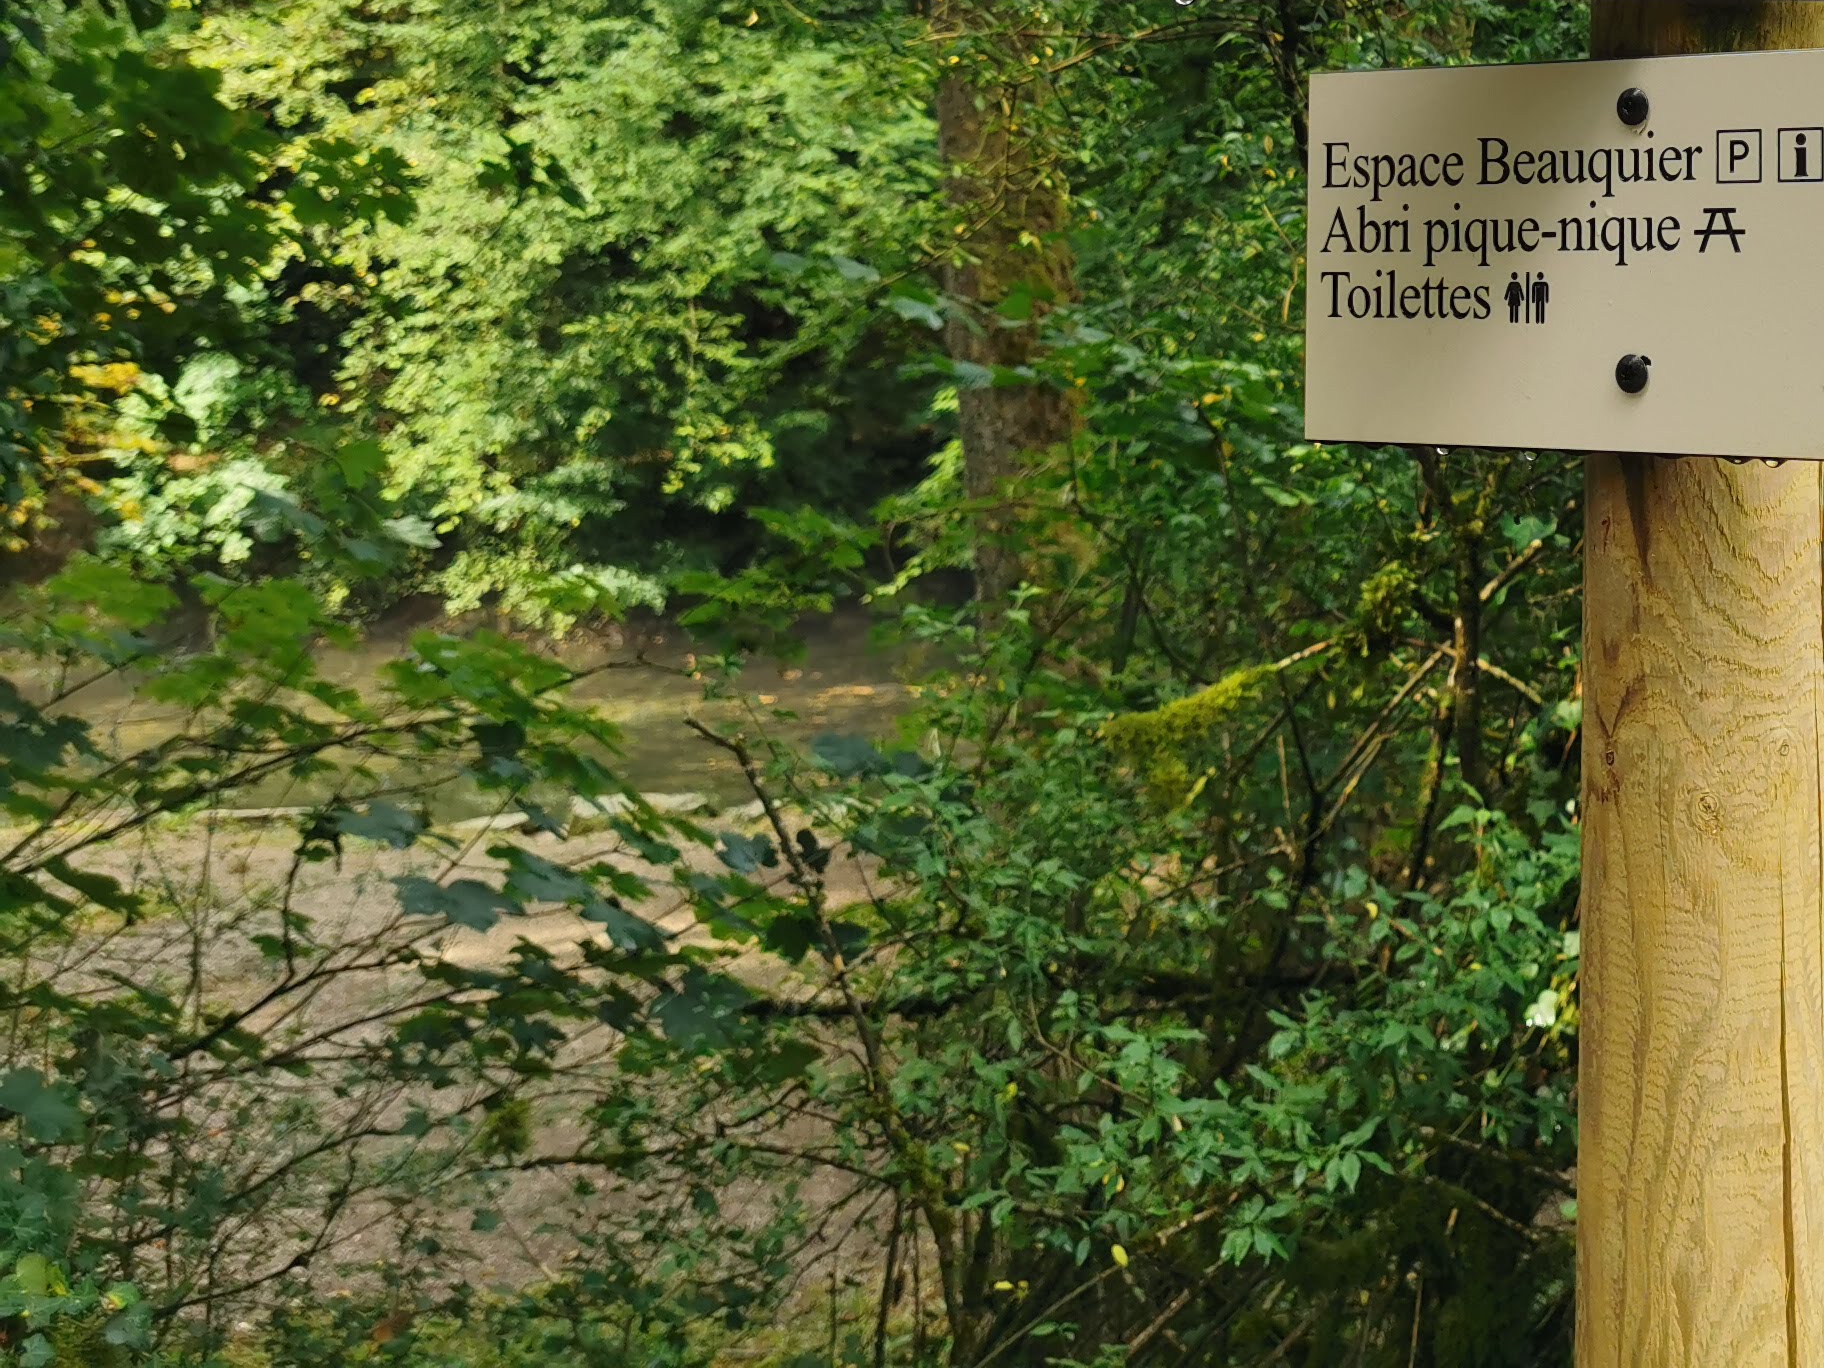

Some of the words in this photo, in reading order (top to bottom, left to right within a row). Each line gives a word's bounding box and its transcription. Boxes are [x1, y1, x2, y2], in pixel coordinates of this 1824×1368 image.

[1322, 142, 1464, 201] Espace
[1477, 131, 1702, 197] Beauquier
[1320, 203, 1411, 253] Abri
[1423, 201, 1681, 266] pique-nique
[1321, 270, 1492, 319] Toilettes
